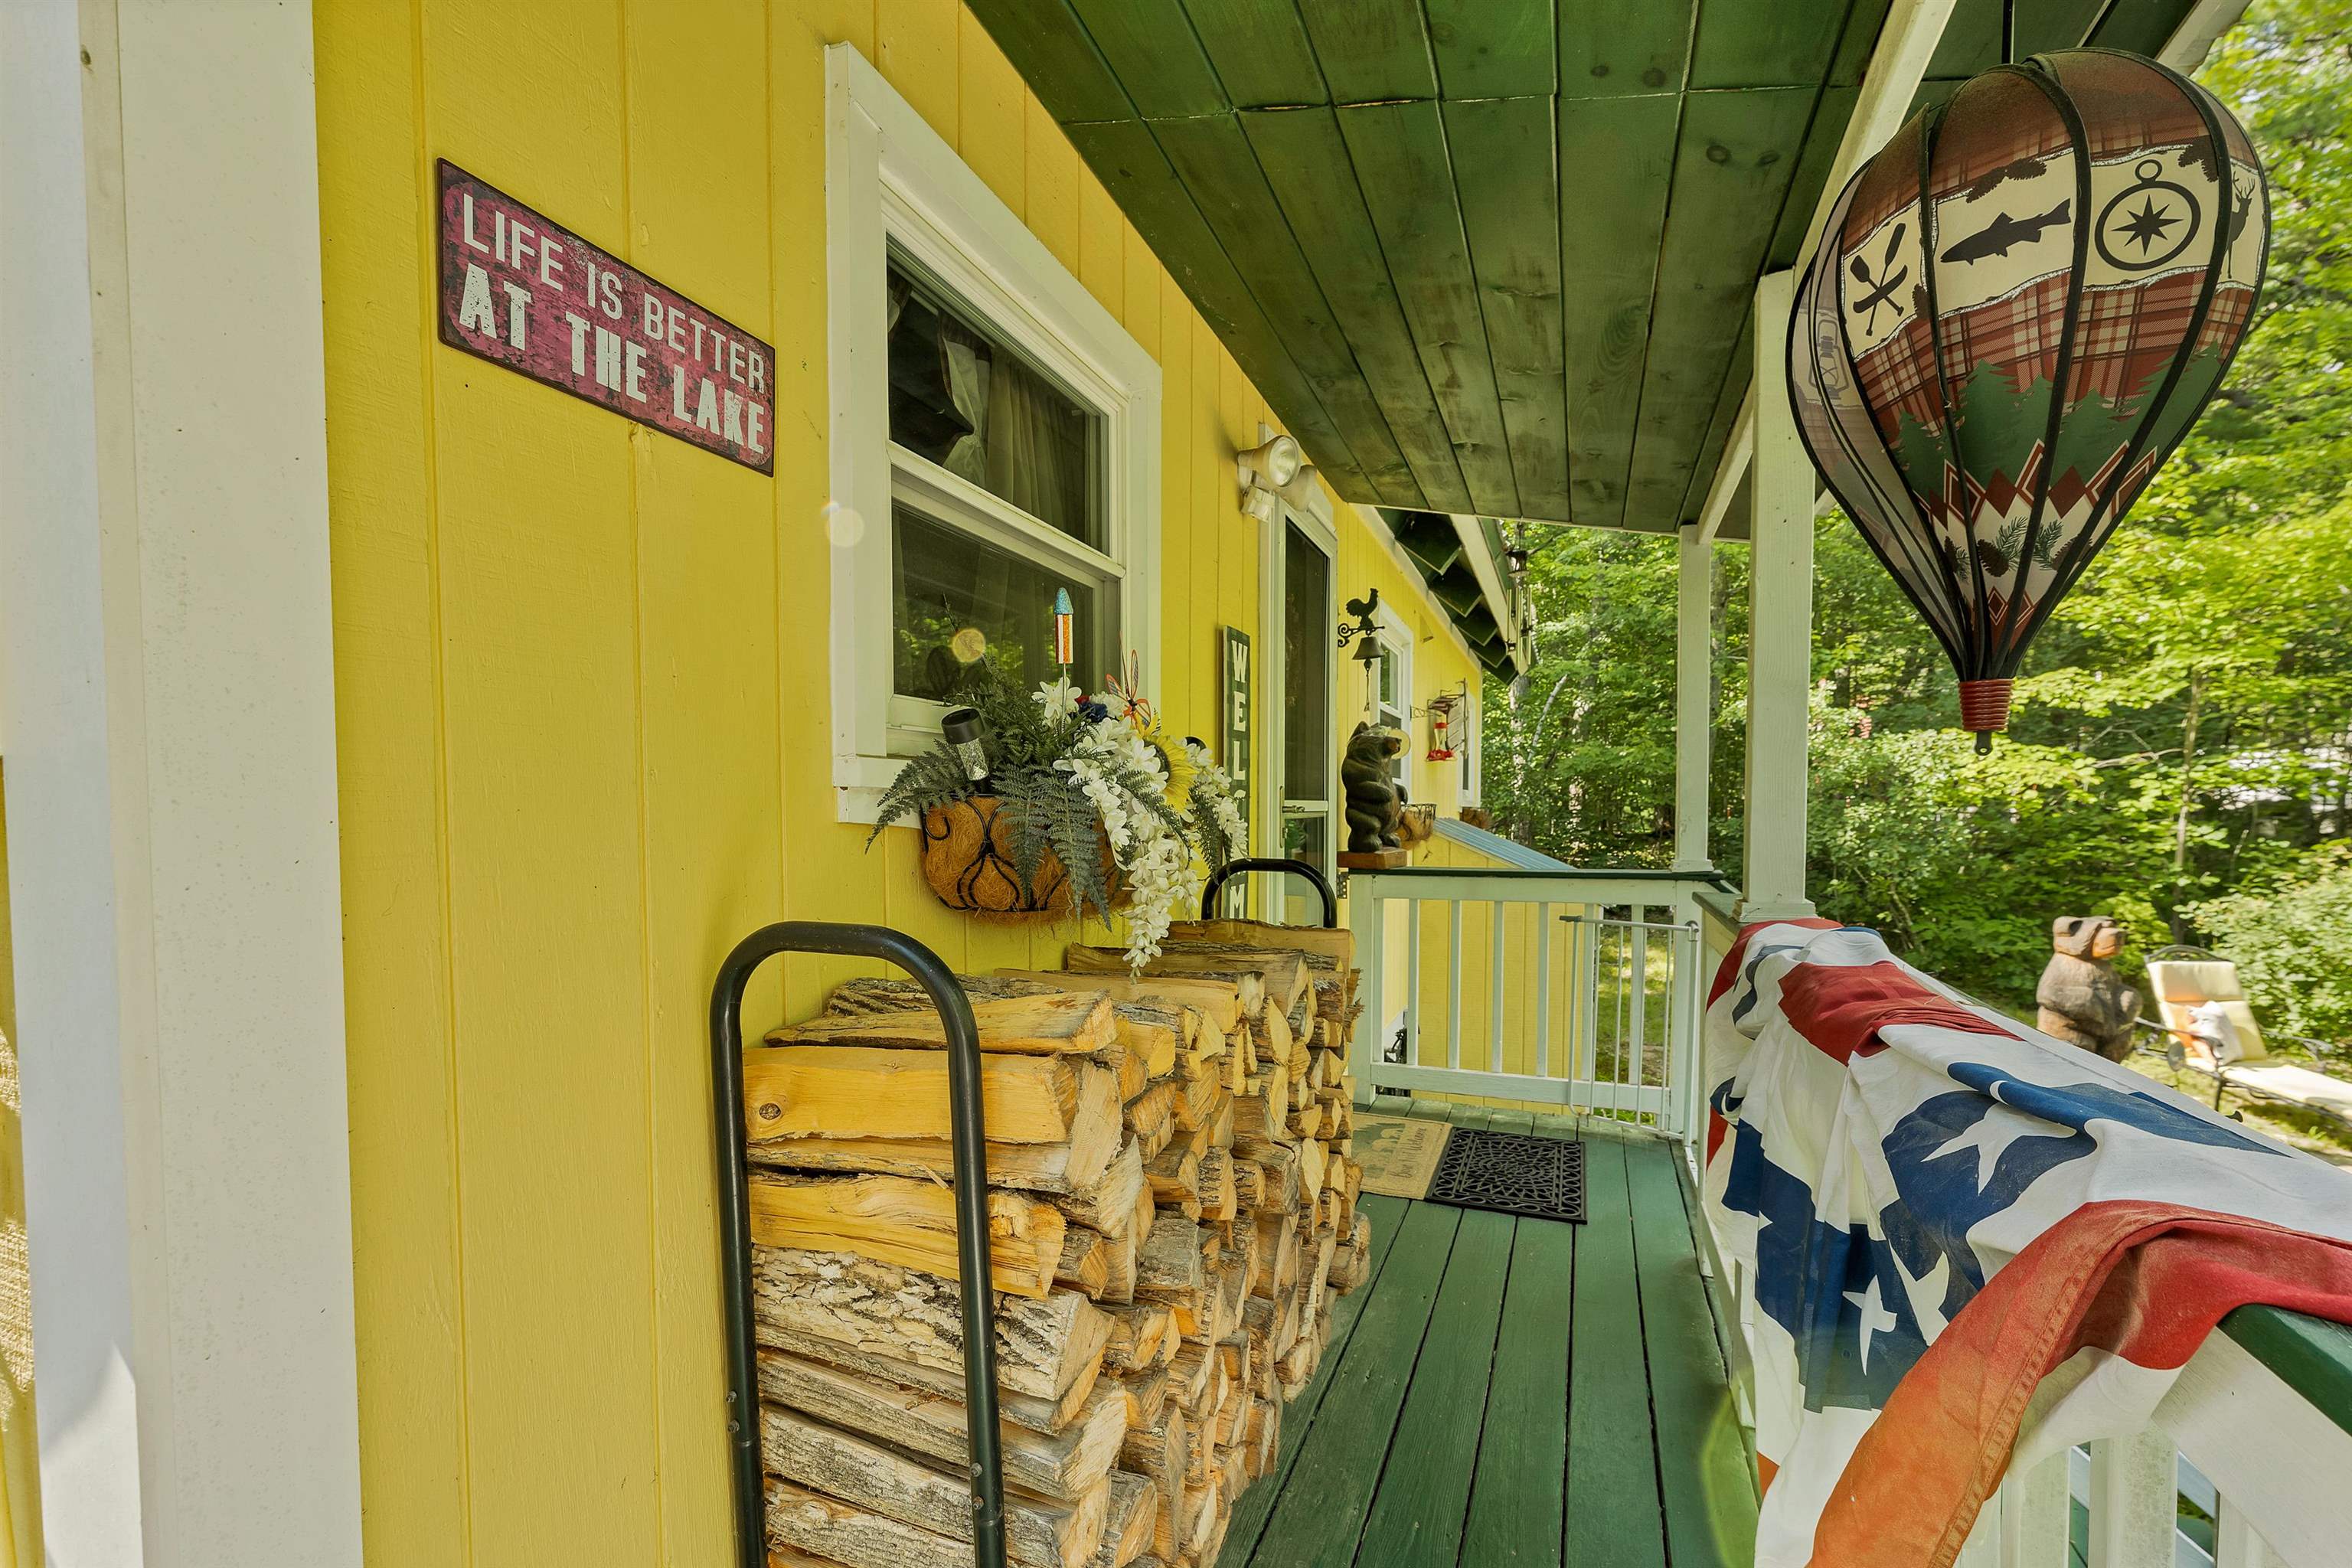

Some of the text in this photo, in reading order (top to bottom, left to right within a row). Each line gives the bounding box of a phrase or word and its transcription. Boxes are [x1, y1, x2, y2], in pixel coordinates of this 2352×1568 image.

[459, 263, 764, 454] AT THE LAKE
[463, 193, 764, 394] LIFE IS BETTER
